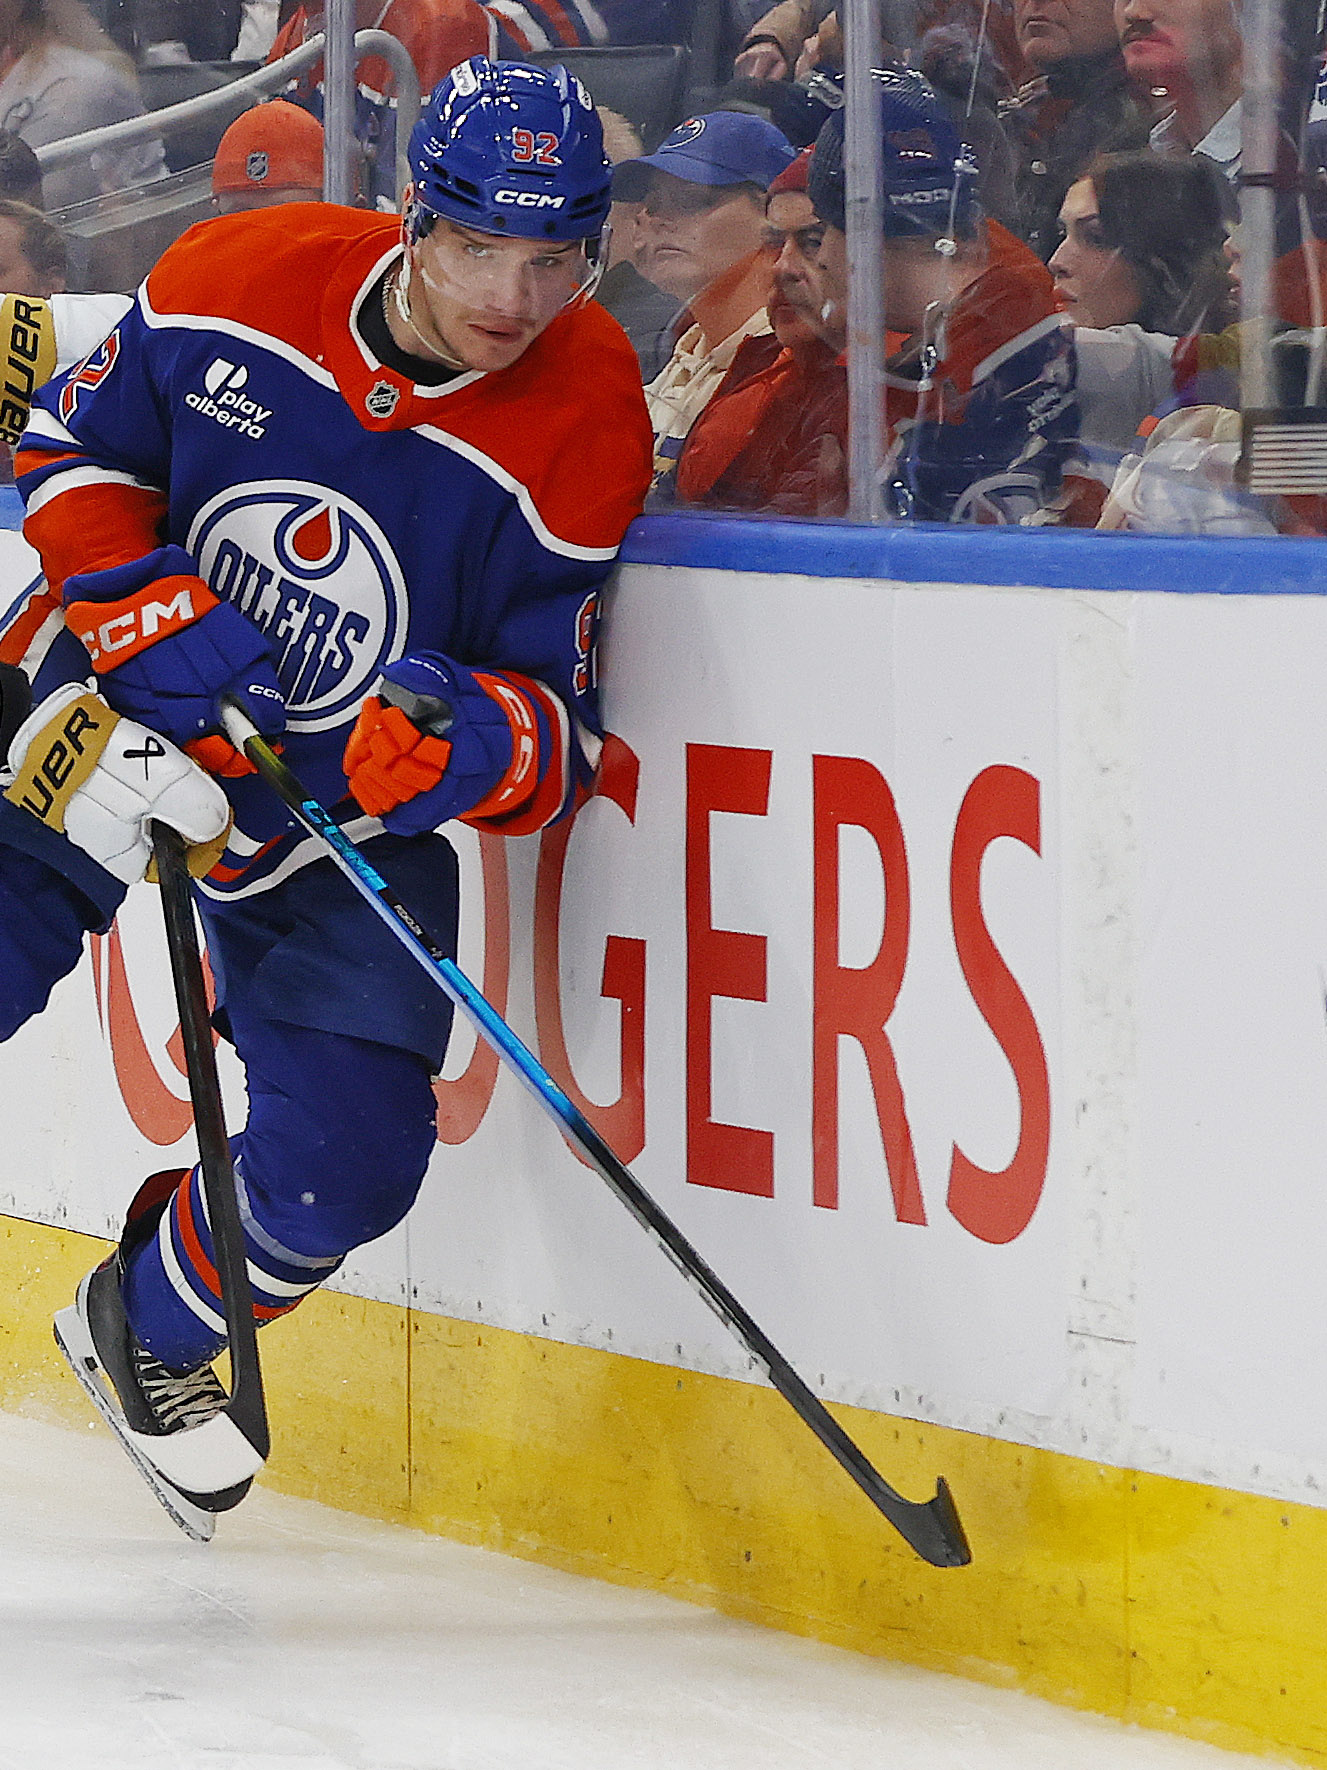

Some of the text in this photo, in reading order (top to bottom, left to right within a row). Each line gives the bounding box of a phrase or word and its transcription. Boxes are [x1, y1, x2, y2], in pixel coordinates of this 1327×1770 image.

[511, 129, 563, 166] 92
[494, 189, 566, 209] CCM
[58, 328, 120, 427] 2
[217, 388, 273, 423] play
[183, 391, 267, 441] alberta
[208, 538, 371, 706] OILERS
[21, 706, 100, 819] UER
[493, 683, 535, 801] CC
